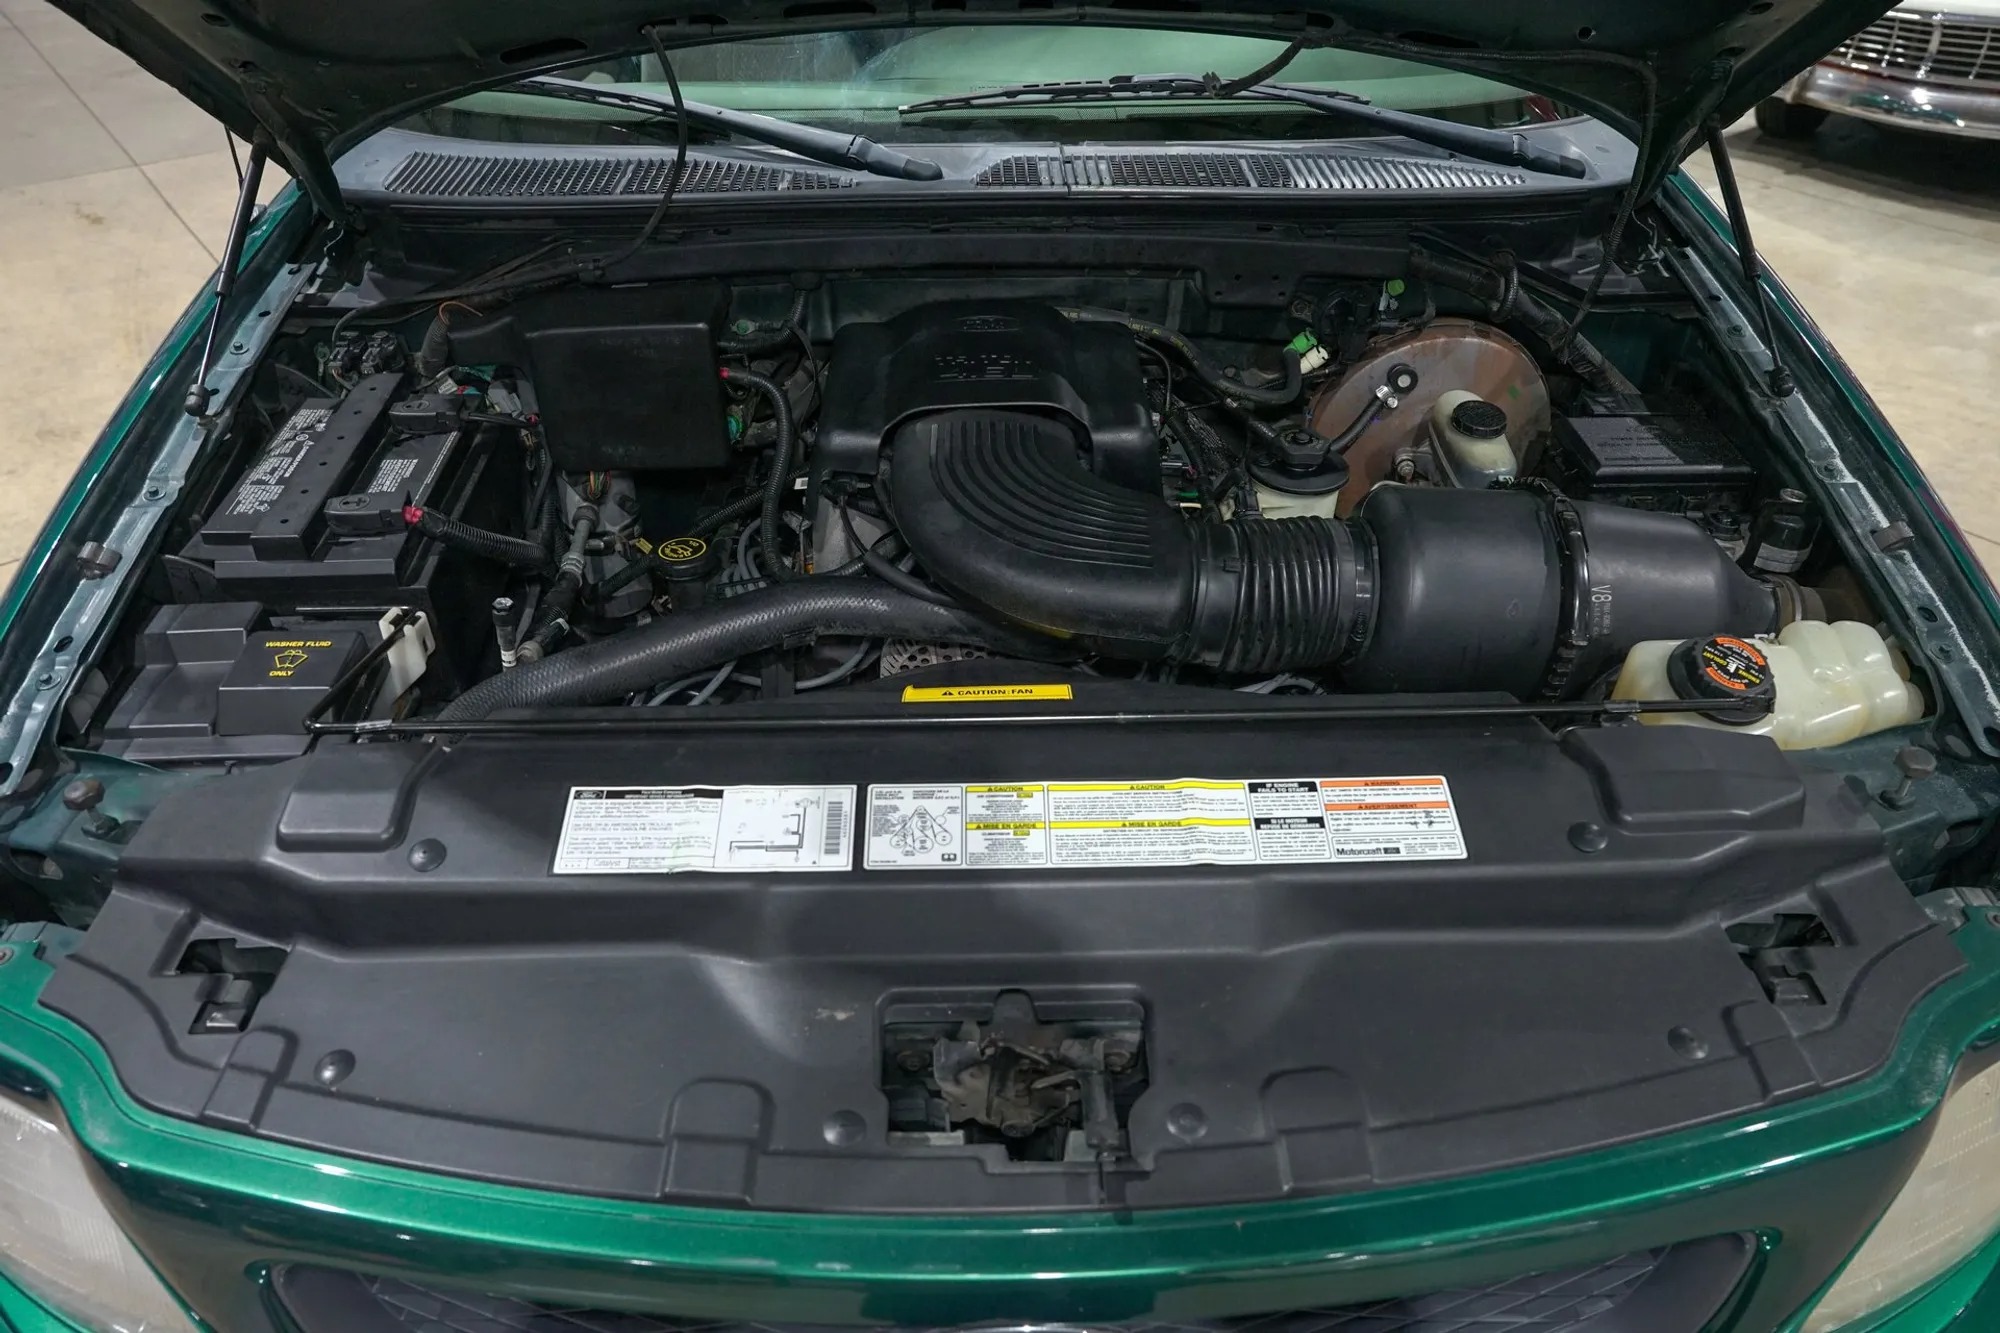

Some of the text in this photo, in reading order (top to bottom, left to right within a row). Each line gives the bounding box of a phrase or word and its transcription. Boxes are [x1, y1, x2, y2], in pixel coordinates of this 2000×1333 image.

[1591, 584, 1612, 603] V8
[1703, 651, 1727, 666] COOLANT
[1738, 669, 1760, 684] ENGINE
[1336, 847, 1383, 856] Motorcraft
[593, 859, 621, 868] Catalyst
